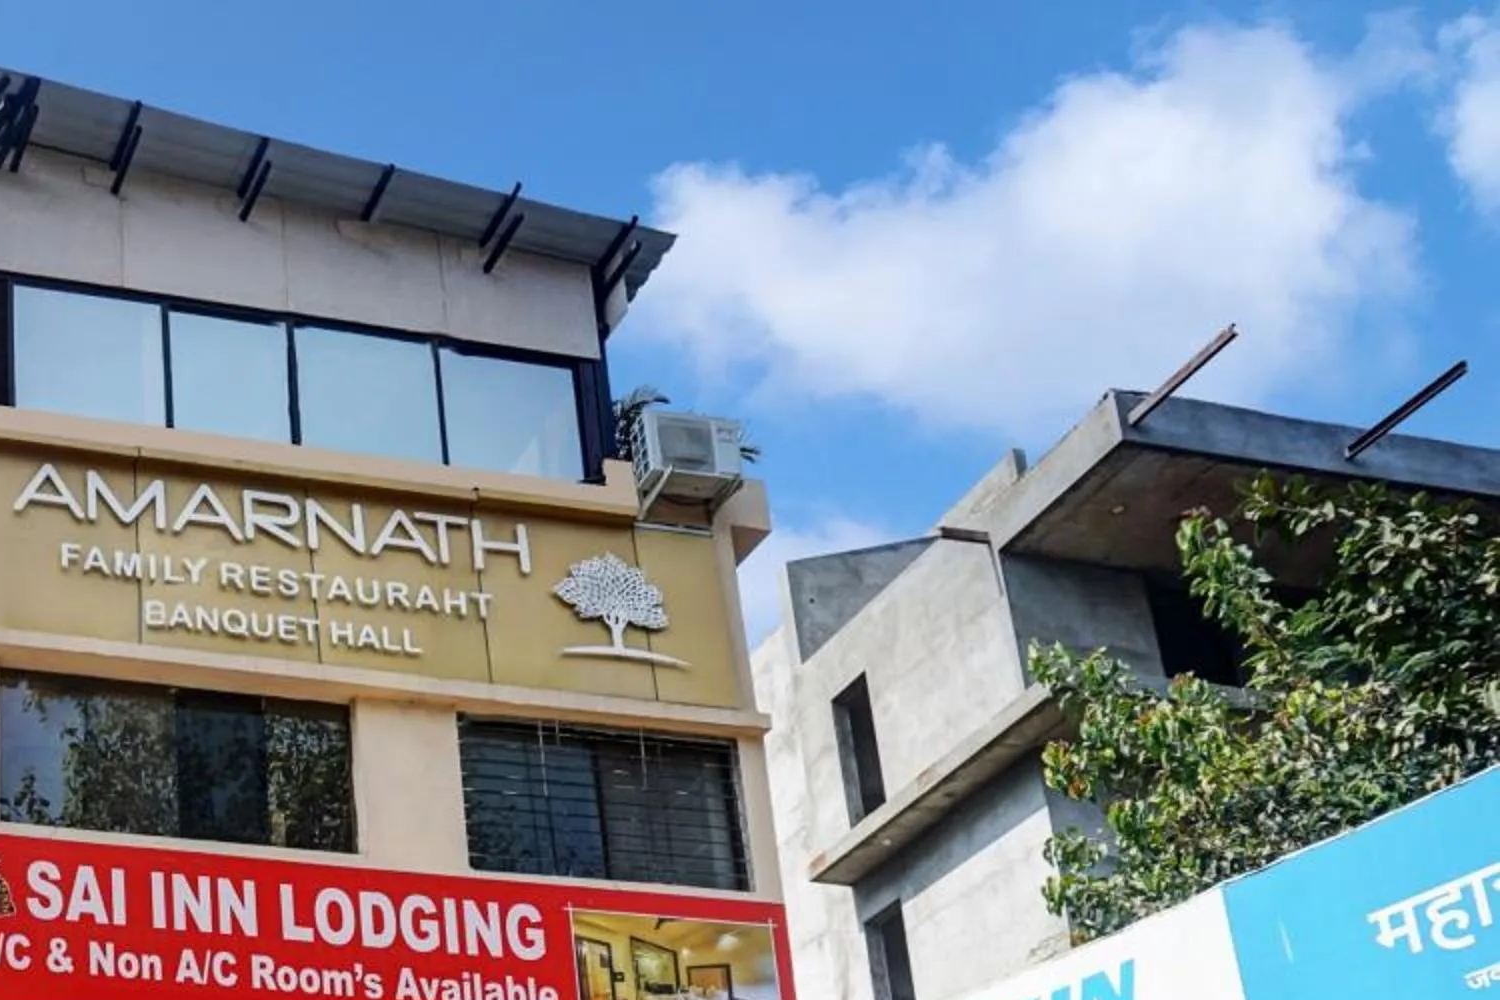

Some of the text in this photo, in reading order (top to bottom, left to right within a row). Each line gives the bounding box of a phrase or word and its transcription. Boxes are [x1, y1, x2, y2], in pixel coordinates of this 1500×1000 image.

[13, 463, 531, 575] AMARNATH
[60, 542, 208, 584] FAMILY
[144, 601, 422, 656] BANQUET HALL
[26, 859, 546, 961] SAI INN LODGING
[1366, 862, 1500, 953] महा
[47, 939, 73, 972] &
[90, 941, 162, 980] Non
[177, 948, 237, 987] A/C
[251, 956, 383, 1000] Room's
